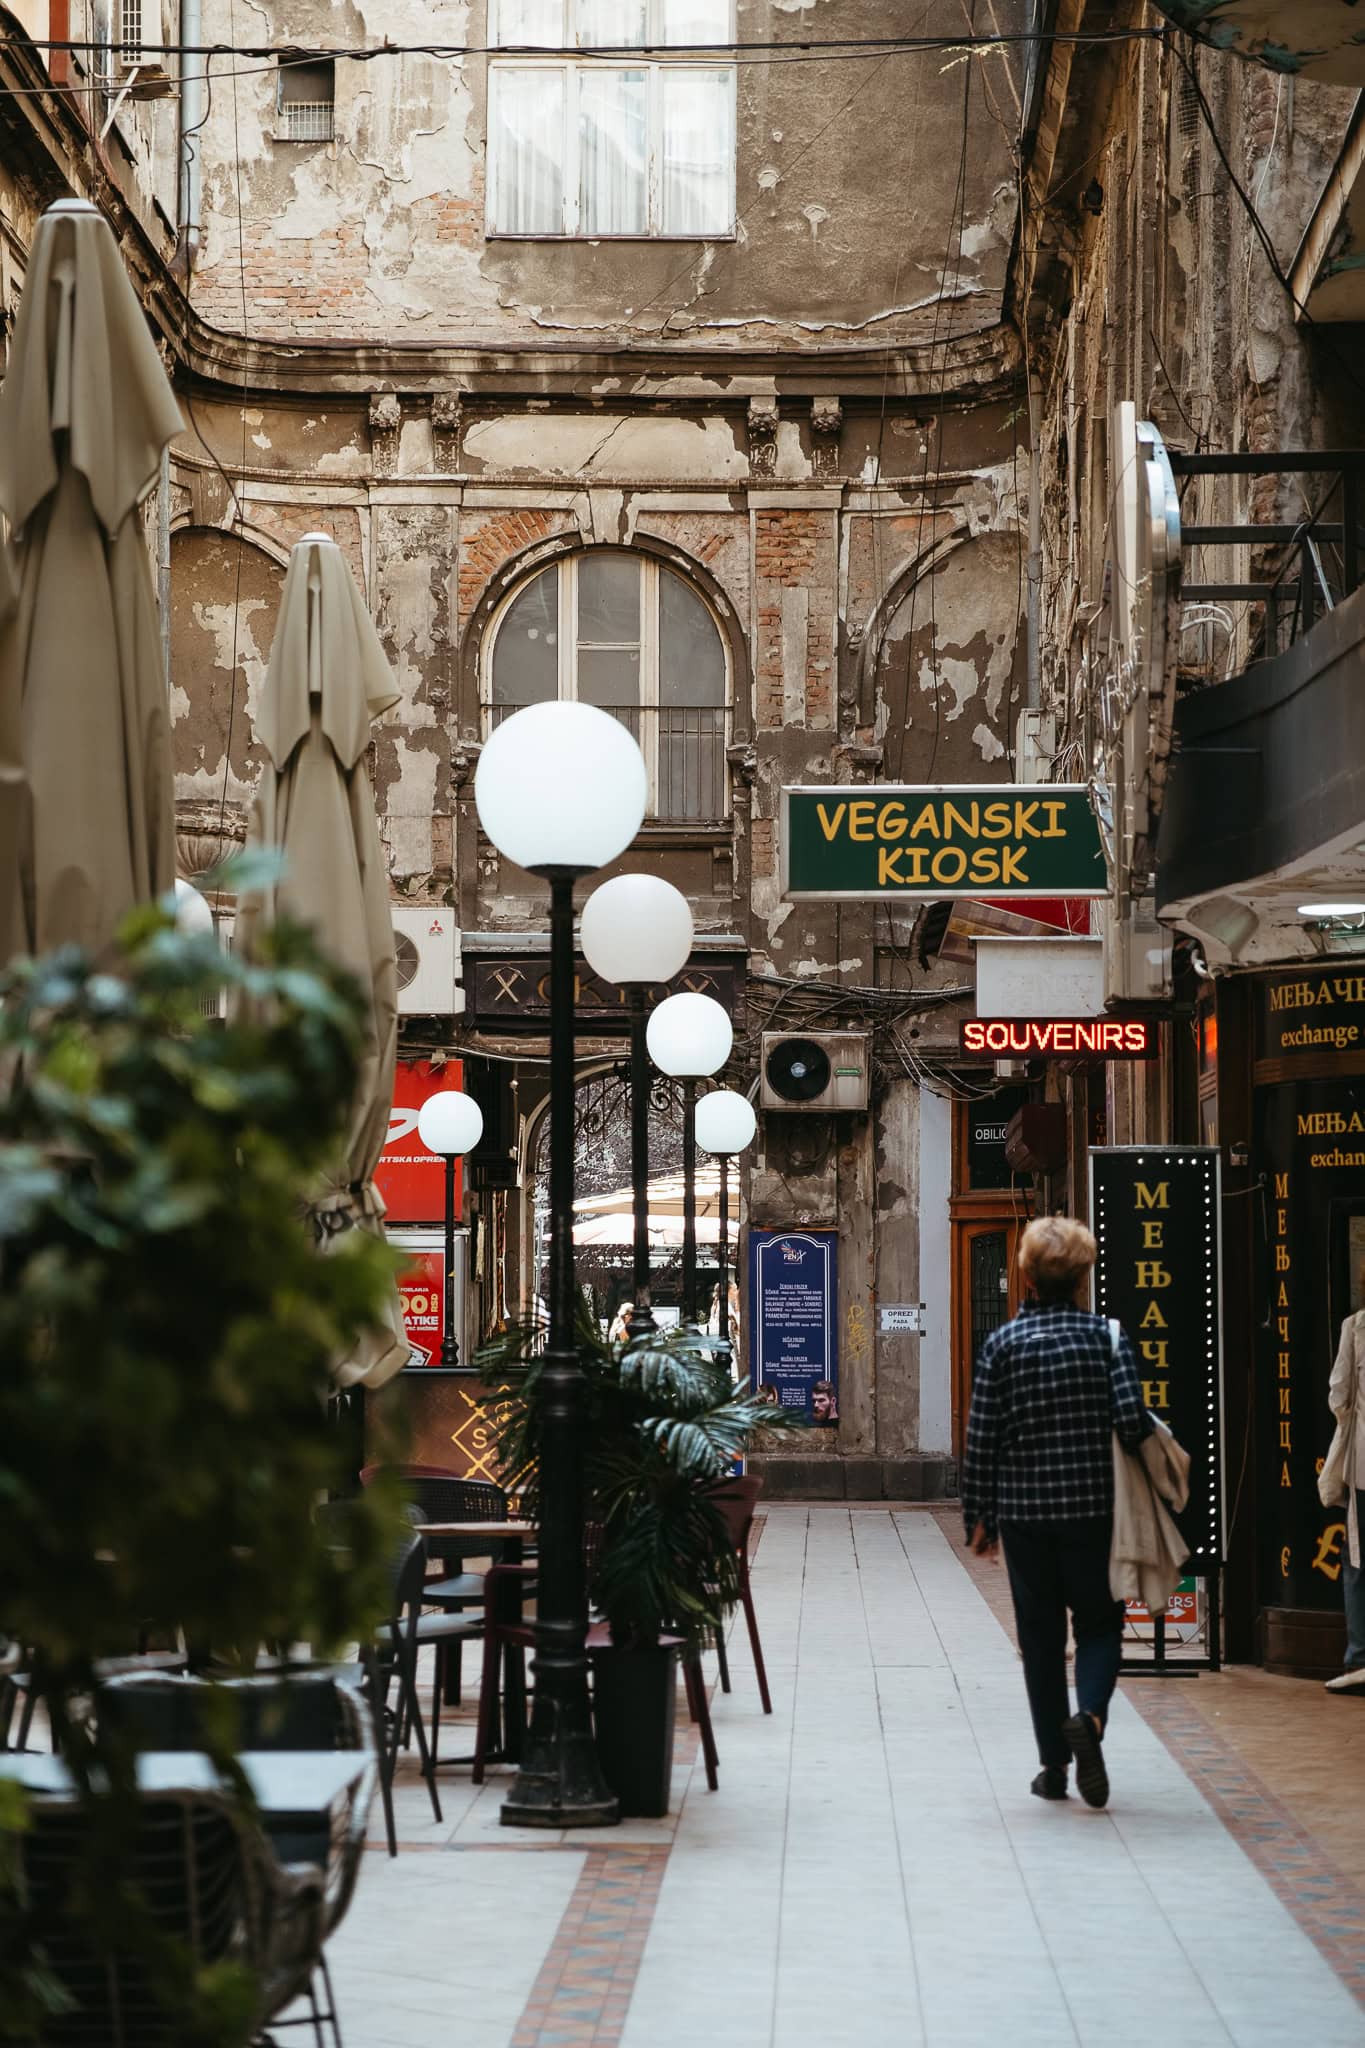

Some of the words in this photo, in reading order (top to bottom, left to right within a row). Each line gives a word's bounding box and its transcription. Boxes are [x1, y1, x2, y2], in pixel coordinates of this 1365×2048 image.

[816, 801, 1067, 841] VEGANSKI
[878, 846, 1030, 885] KIOSK
[963, 1023, 1146, 1051] SOUVENIRS
[1280, 1023, 1359, 1048] exchange
[1297, 1111, 1365, 1136] МЕЊА
[1310, 1147, 1365, 1168] exchan
[1133, 1182, 1172, 1424] МЕЊАЧН
[403, 1316, 439, 1325] ATIKE
[1275, 1173, 1292, 1487] МЕЊАЧНИЦА
